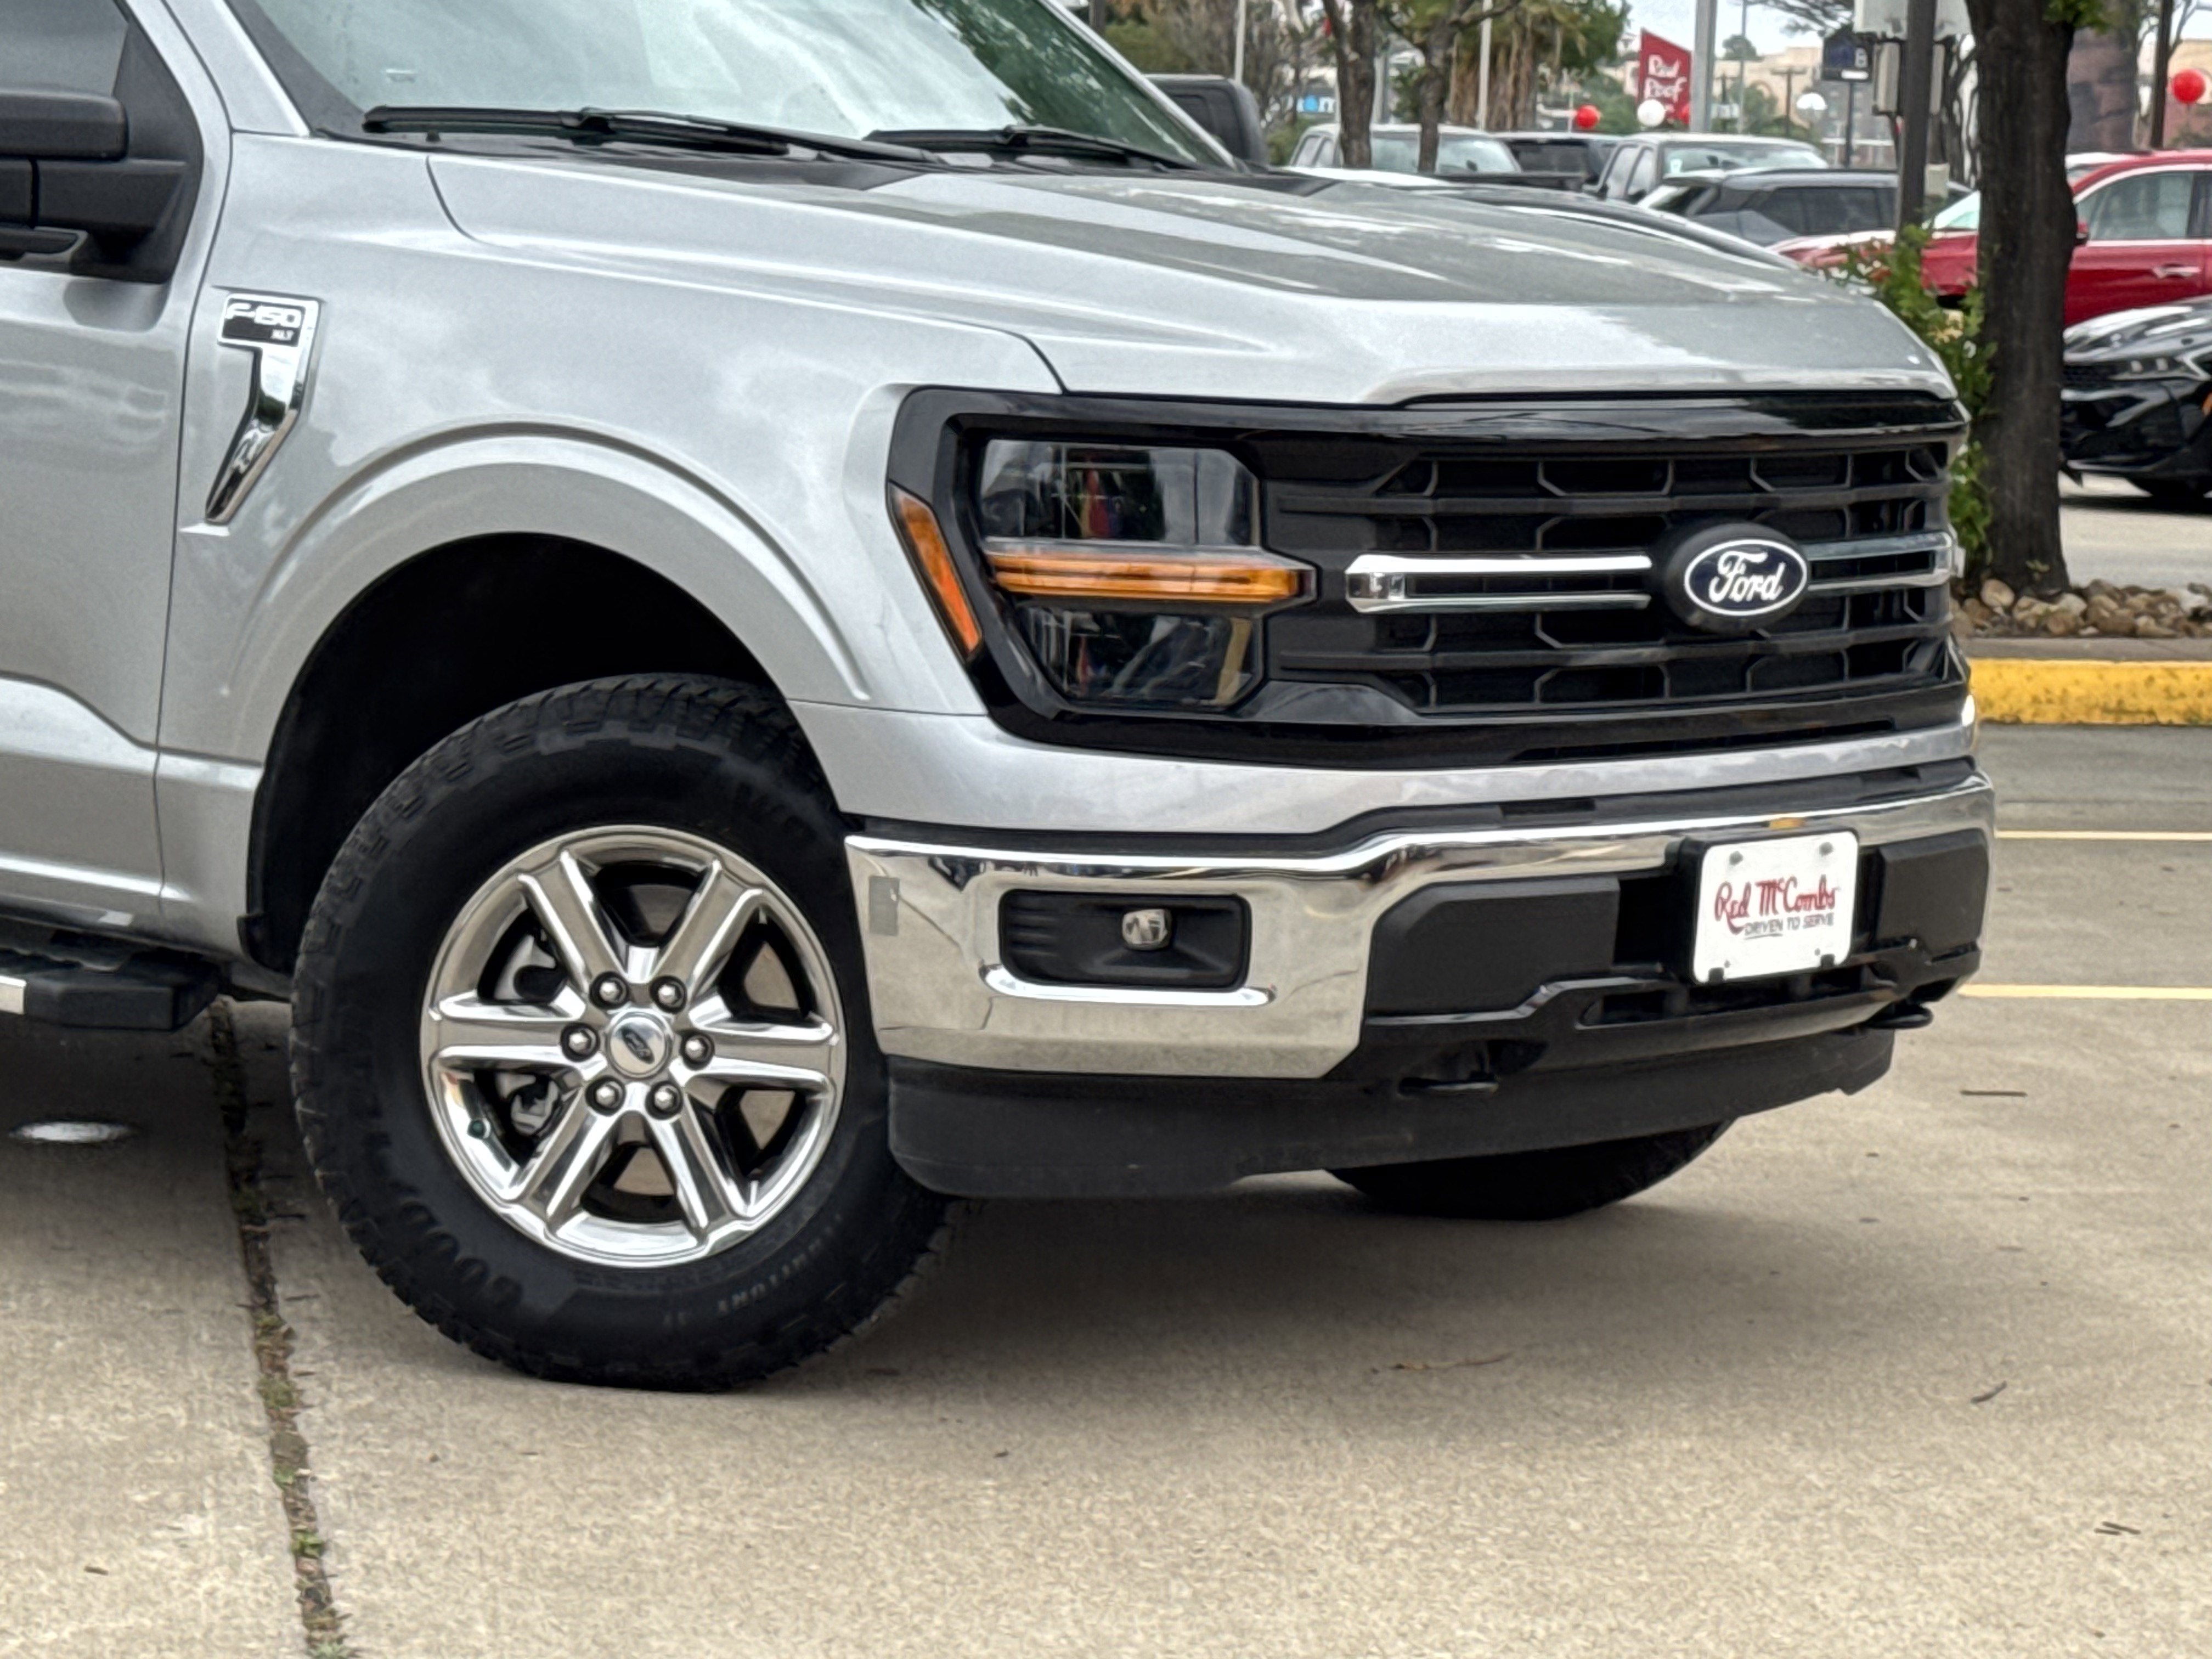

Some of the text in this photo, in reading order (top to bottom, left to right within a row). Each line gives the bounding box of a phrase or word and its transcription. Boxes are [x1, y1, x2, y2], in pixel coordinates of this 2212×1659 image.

[224, 302, 302, 328] F-150
[1708, 550, 1786, 603] Ford
[1714, 880, 1752, 935] Red
[1744, 912, 1835, 936] DRIVEN TO SERVE
